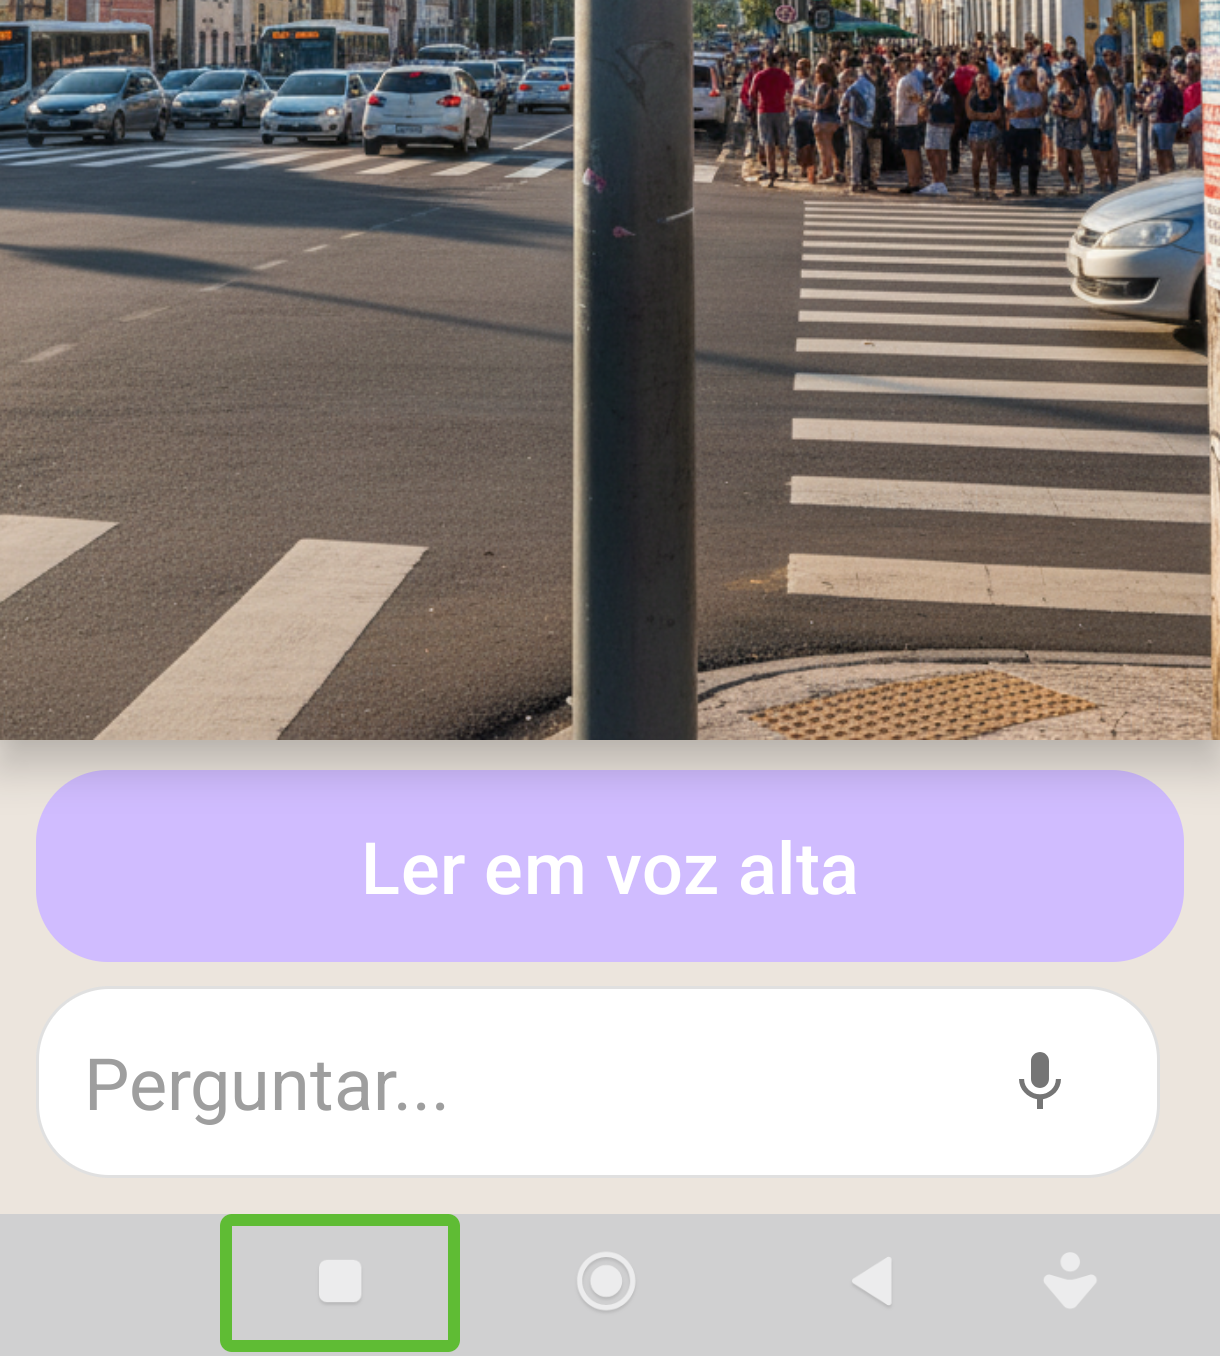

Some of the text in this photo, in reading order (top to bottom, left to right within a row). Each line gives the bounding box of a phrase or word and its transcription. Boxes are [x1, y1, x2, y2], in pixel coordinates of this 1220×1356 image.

[366, 840, 856, 895] Ler em voz alta
[90, 1059, 448, 1125] Perguntar...
